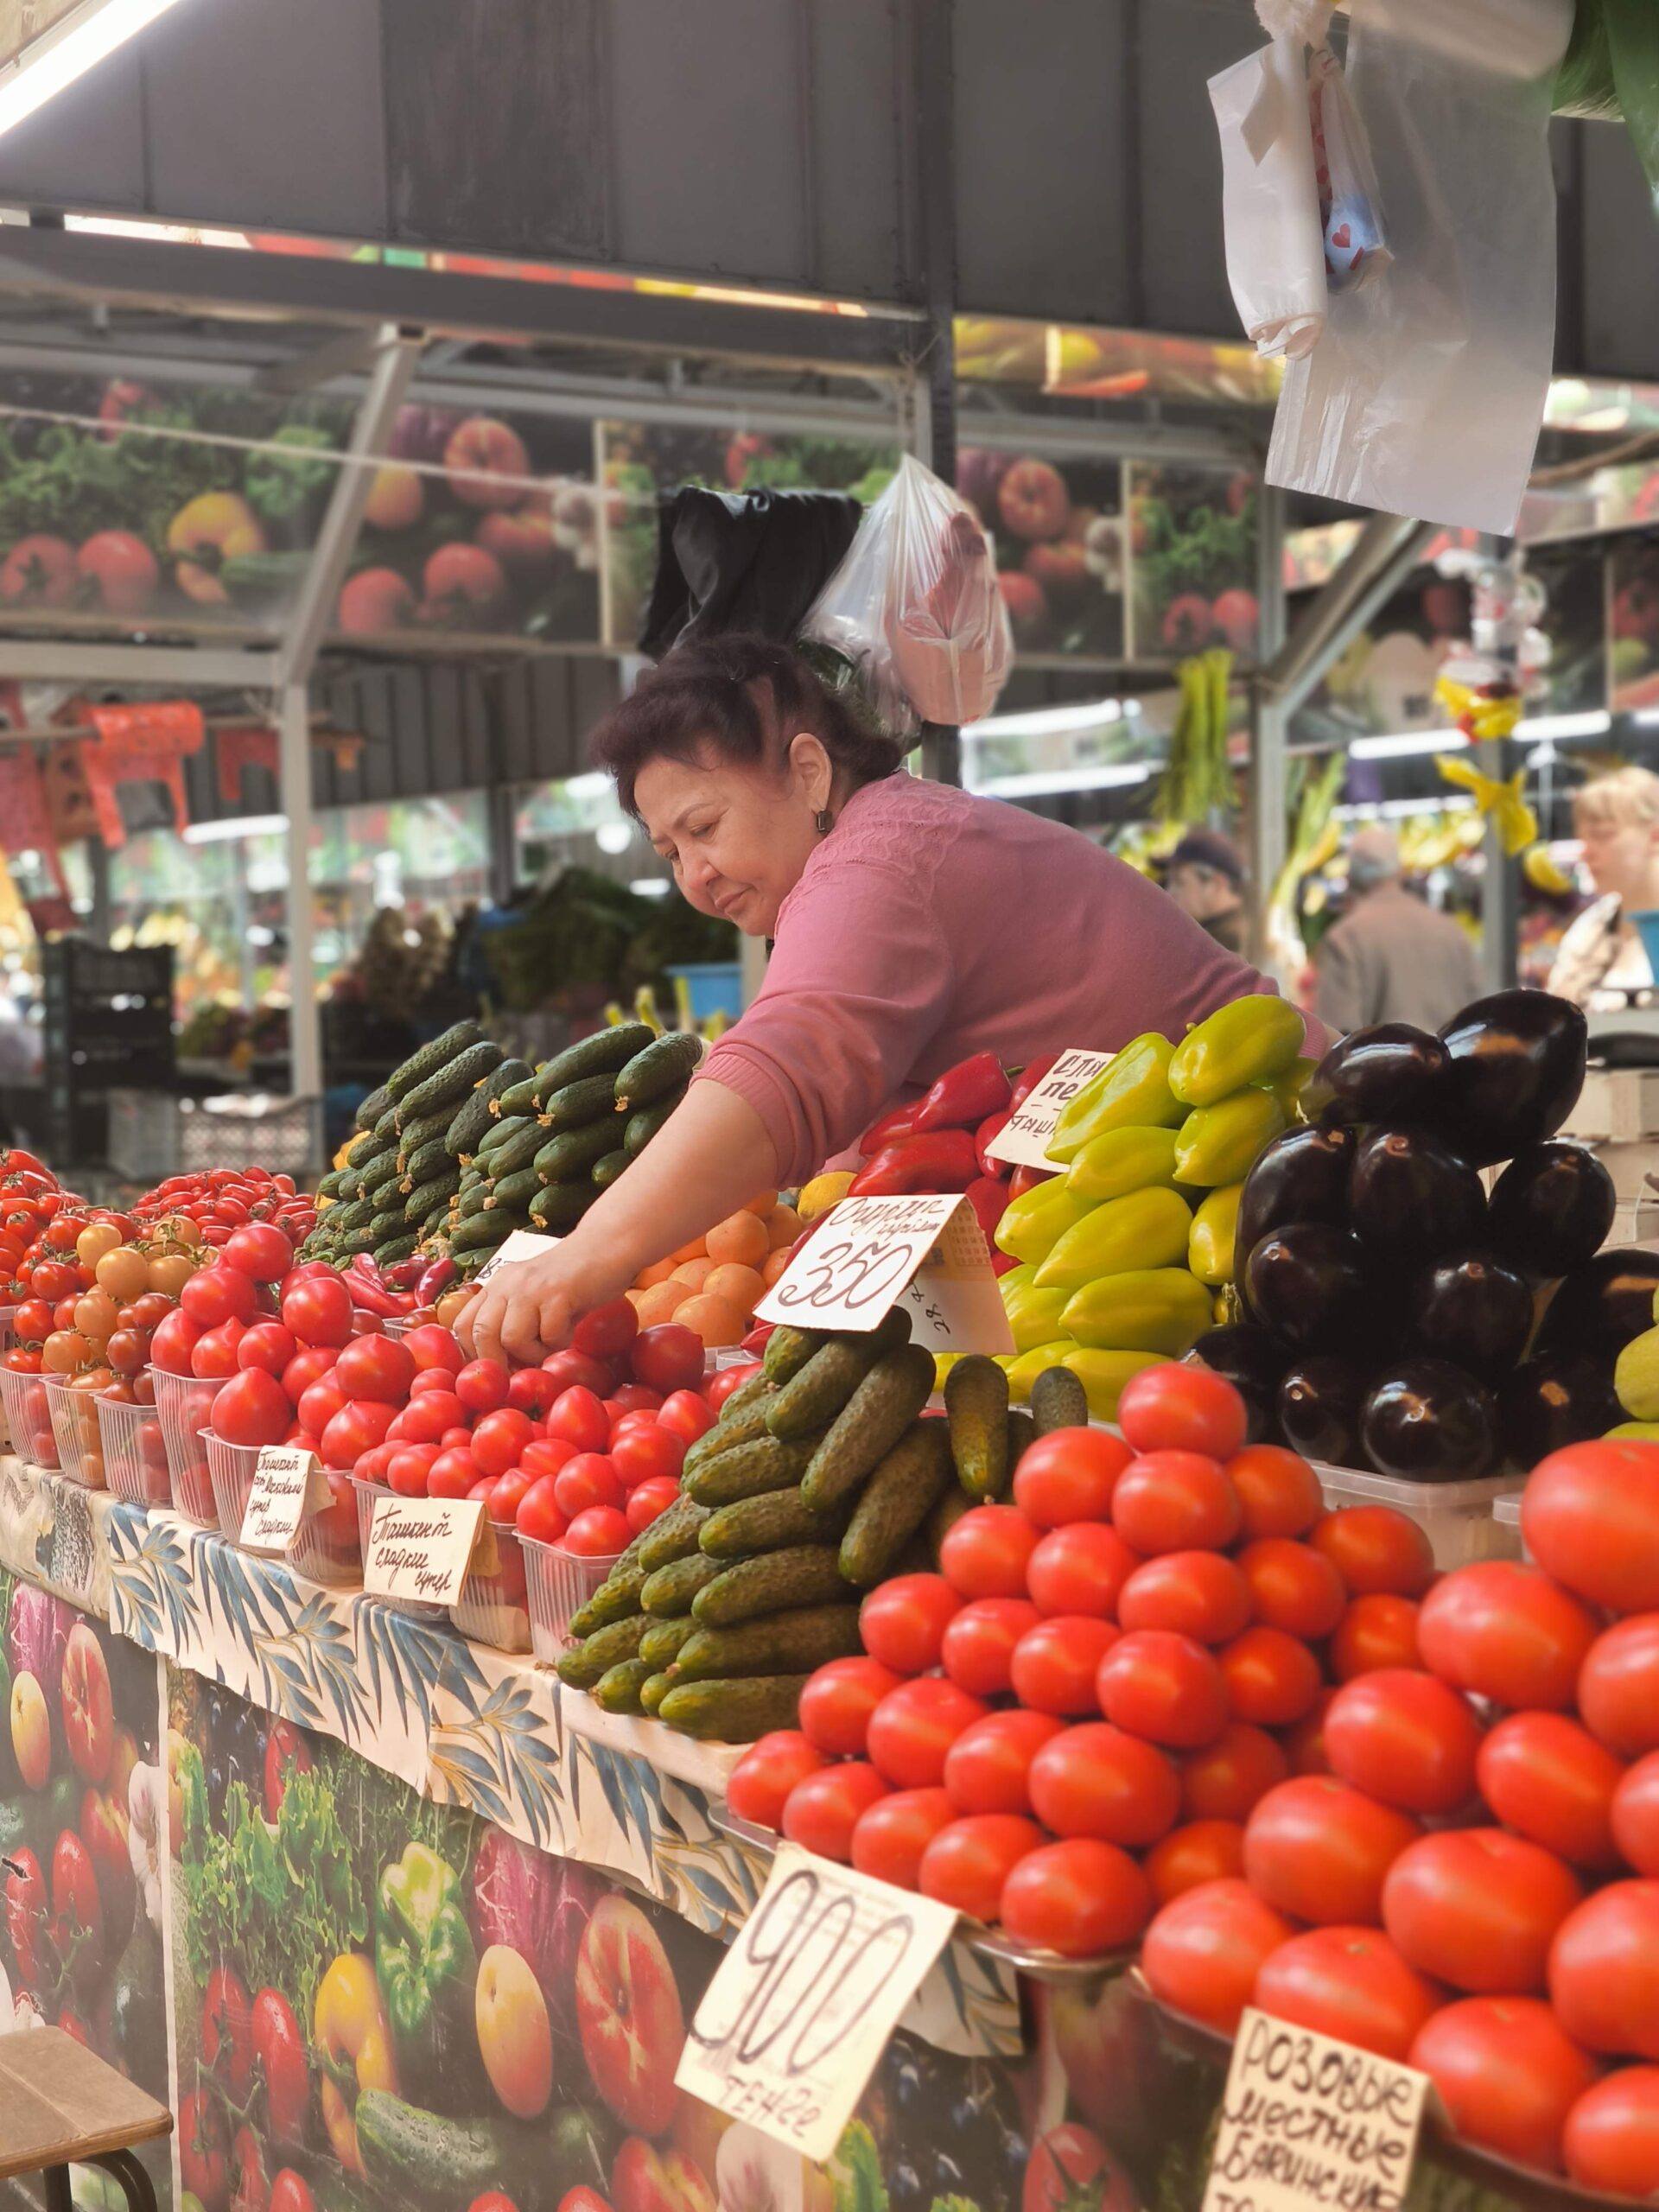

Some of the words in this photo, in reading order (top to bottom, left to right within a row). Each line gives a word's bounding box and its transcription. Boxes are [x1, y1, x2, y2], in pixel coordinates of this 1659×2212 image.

[777, 1241, 913, 1310] 350
[414, 1568, 453, 1598] супер
[690, 1869, 915, 2077] 900
